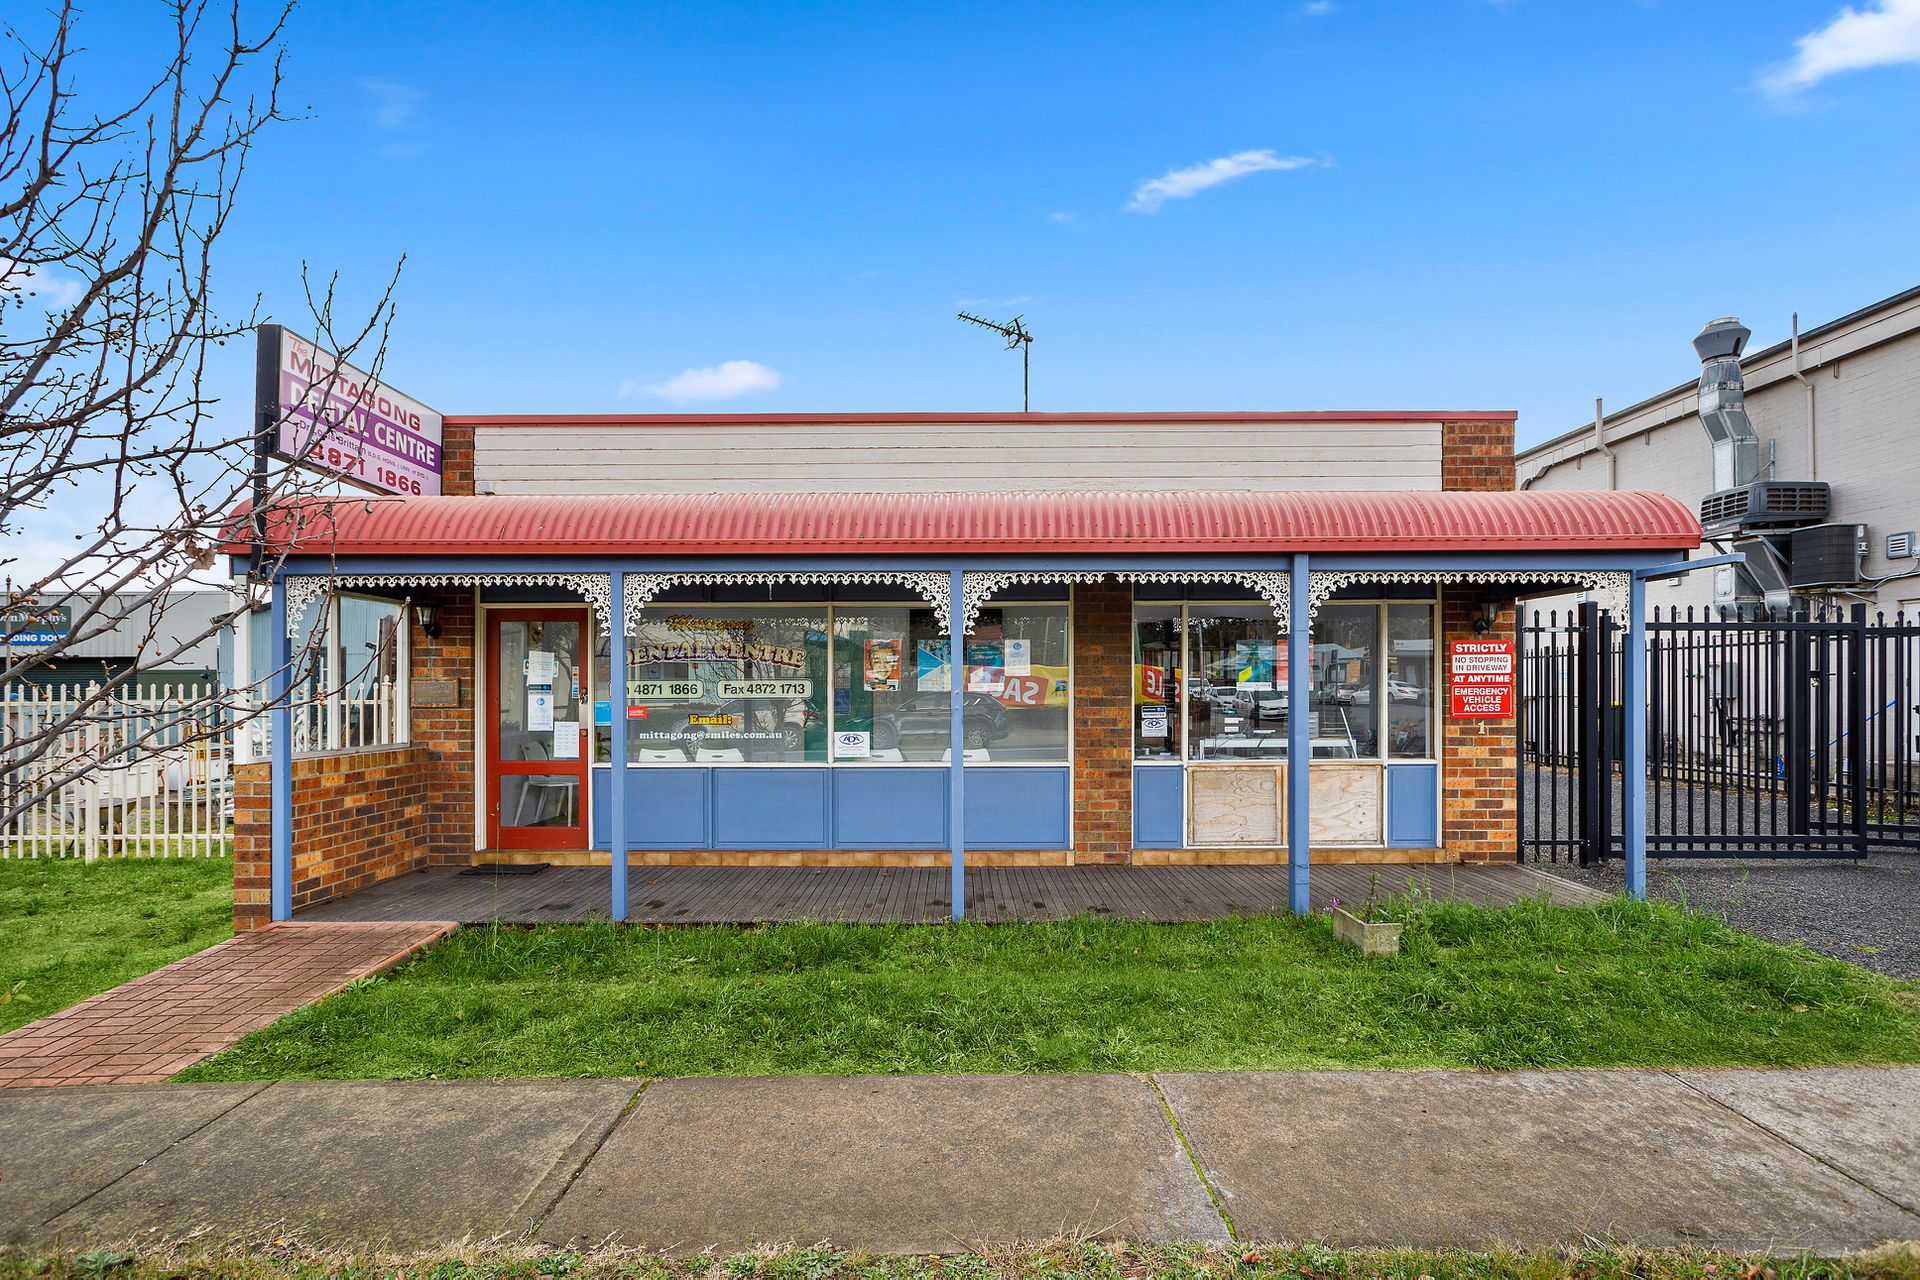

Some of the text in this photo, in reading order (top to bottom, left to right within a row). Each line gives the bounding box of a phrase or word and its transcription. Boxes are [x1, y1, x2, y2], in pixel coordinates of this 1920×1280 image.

[288, 335, 308, 357] The
[290, 351, 421, 432] MITTAGONG
[374, 421, 435, 467] CENTRE
[311, 442, 422, 497] 4871 1866
[1455, 644, 1507, 652] STRICTLY
[1453, 675, 1510, 683] AT ANYTIME
[634, 683, 663, 695] 4871
[668, 683, 698, 695] 1866
[724, 683, 805, 695] Fax 4872 1713
[1454, 687, 1508, 695] EMERGENCY
[1463, 695, 1502, 703] VEHICLE
[1463, 704, 1501, 712] ACCESS
[688, 714, 733, 726] Email:
[1477, 720, 1486, 735] 1
[639, 731, 783, 741] mittagong@smiles.com.au
[843, 735, 861, 743] ADA
